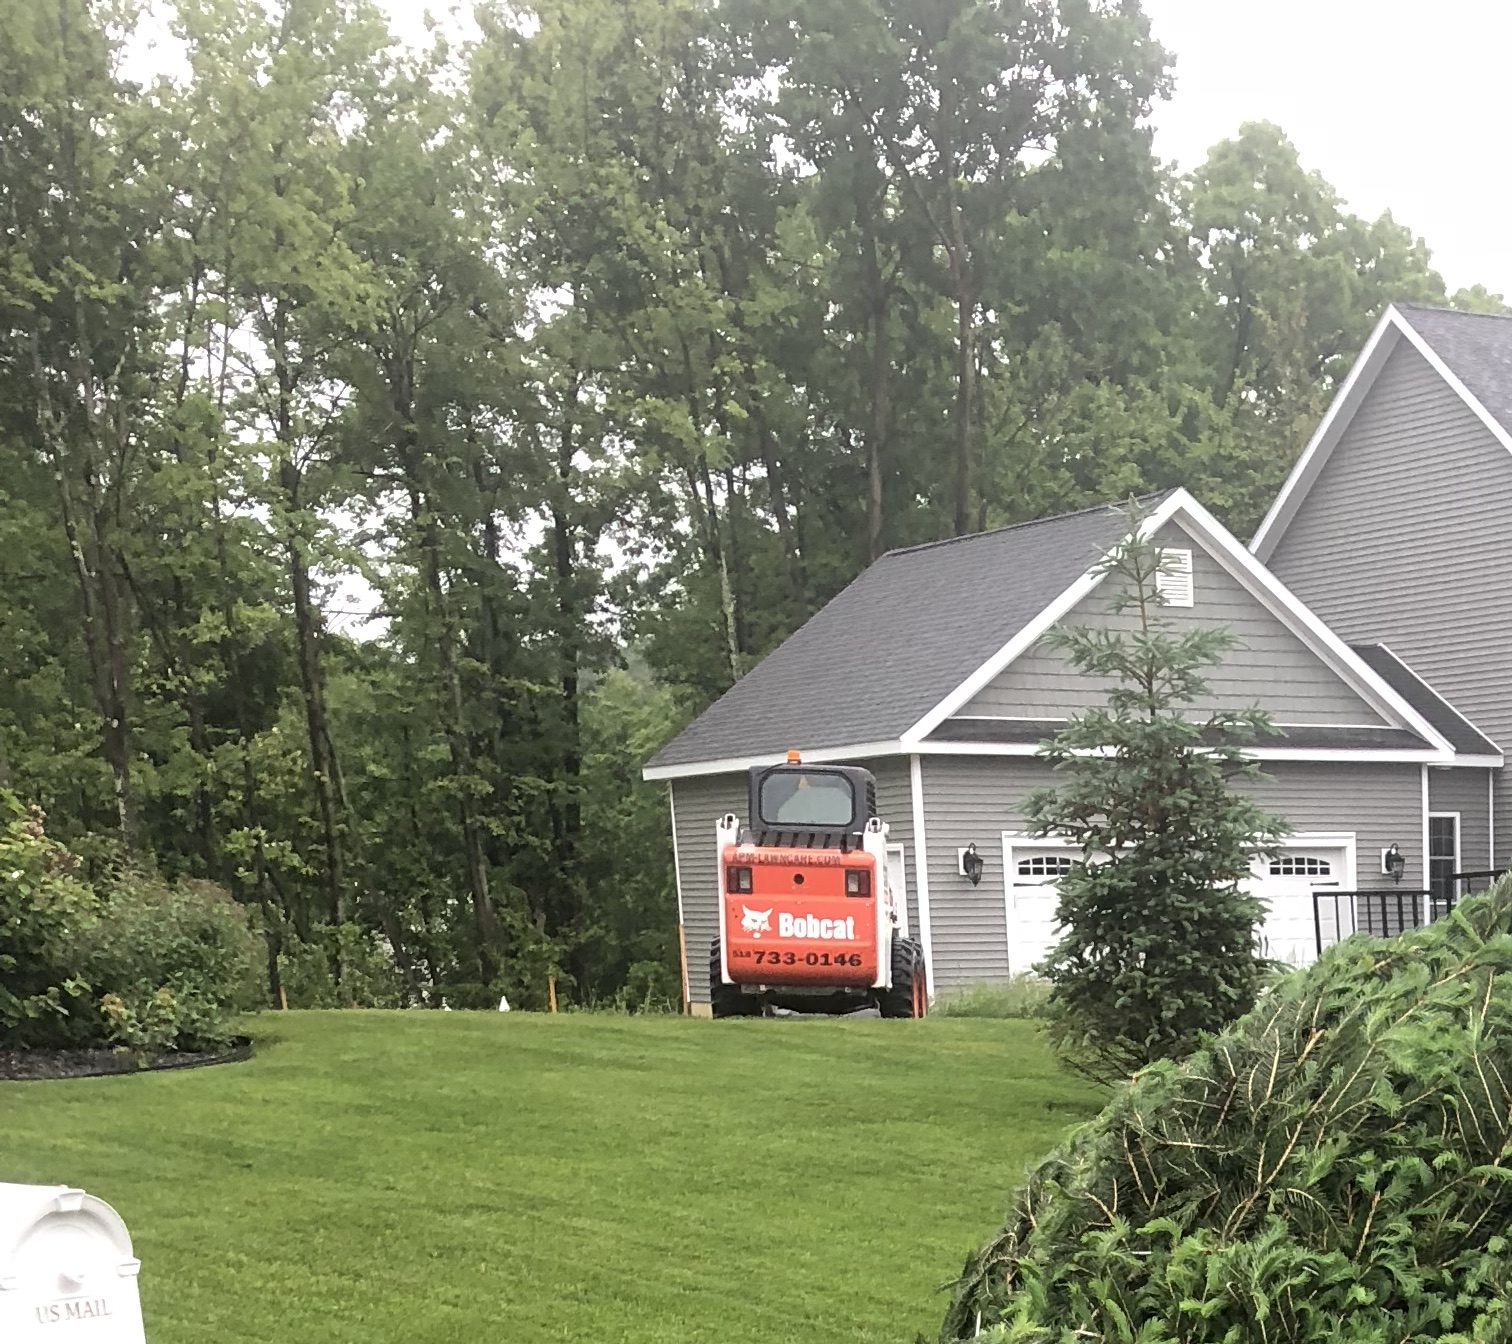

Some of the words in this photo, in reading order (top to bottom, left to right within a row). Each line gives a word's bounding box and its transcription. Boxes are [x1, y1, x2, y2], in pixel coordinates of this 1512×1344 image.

[778, 912, 855, 940] Bobcat
[754, 951, 862, 967] 733-0146
[36, 1304, 60, 1324] US
[65, 1299, 112, 1320] MAIL
